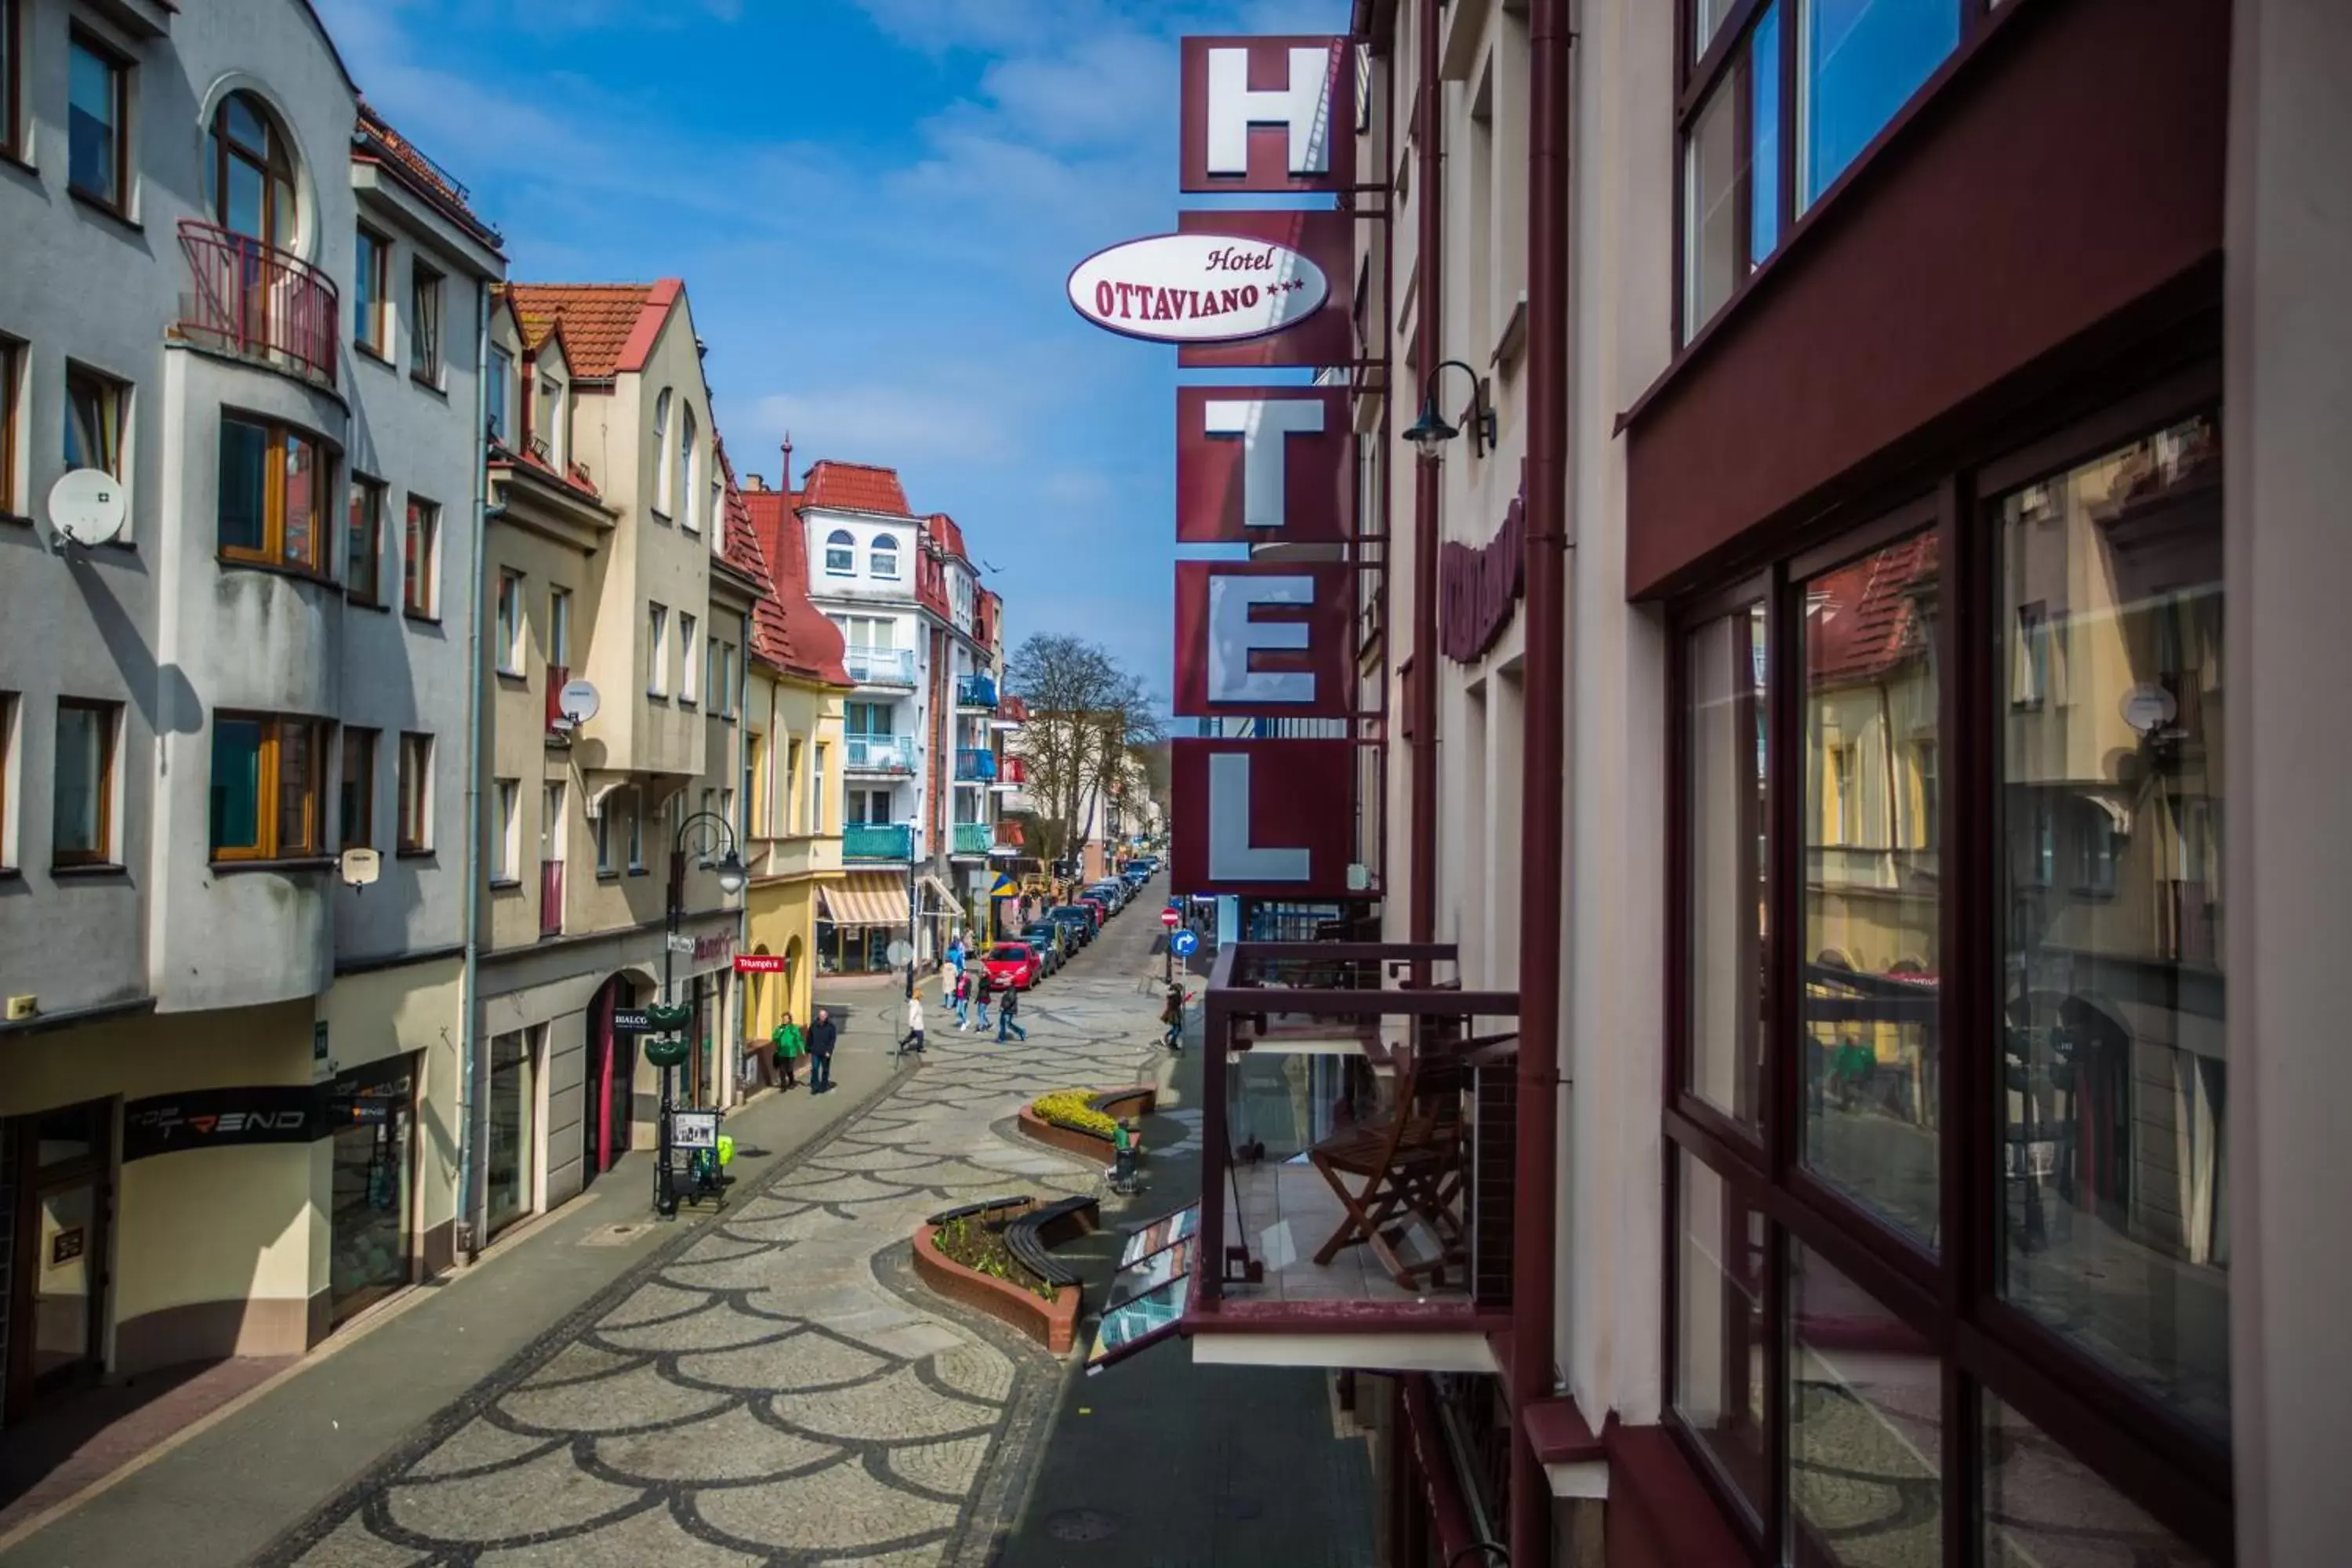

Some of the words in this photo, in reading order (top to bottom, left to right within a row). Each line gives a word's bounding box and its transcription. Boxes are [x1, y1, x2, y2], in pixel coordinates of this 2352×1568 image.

[1206, 246, 1276, 271] Hotel
[1095, 280, 1259, 321] OTTAVIANO
[1205, 48, 1330, 881] HTEL
[740, 959, 772, 970] Triumph
[158, 1111, 306, 1139] TREND
